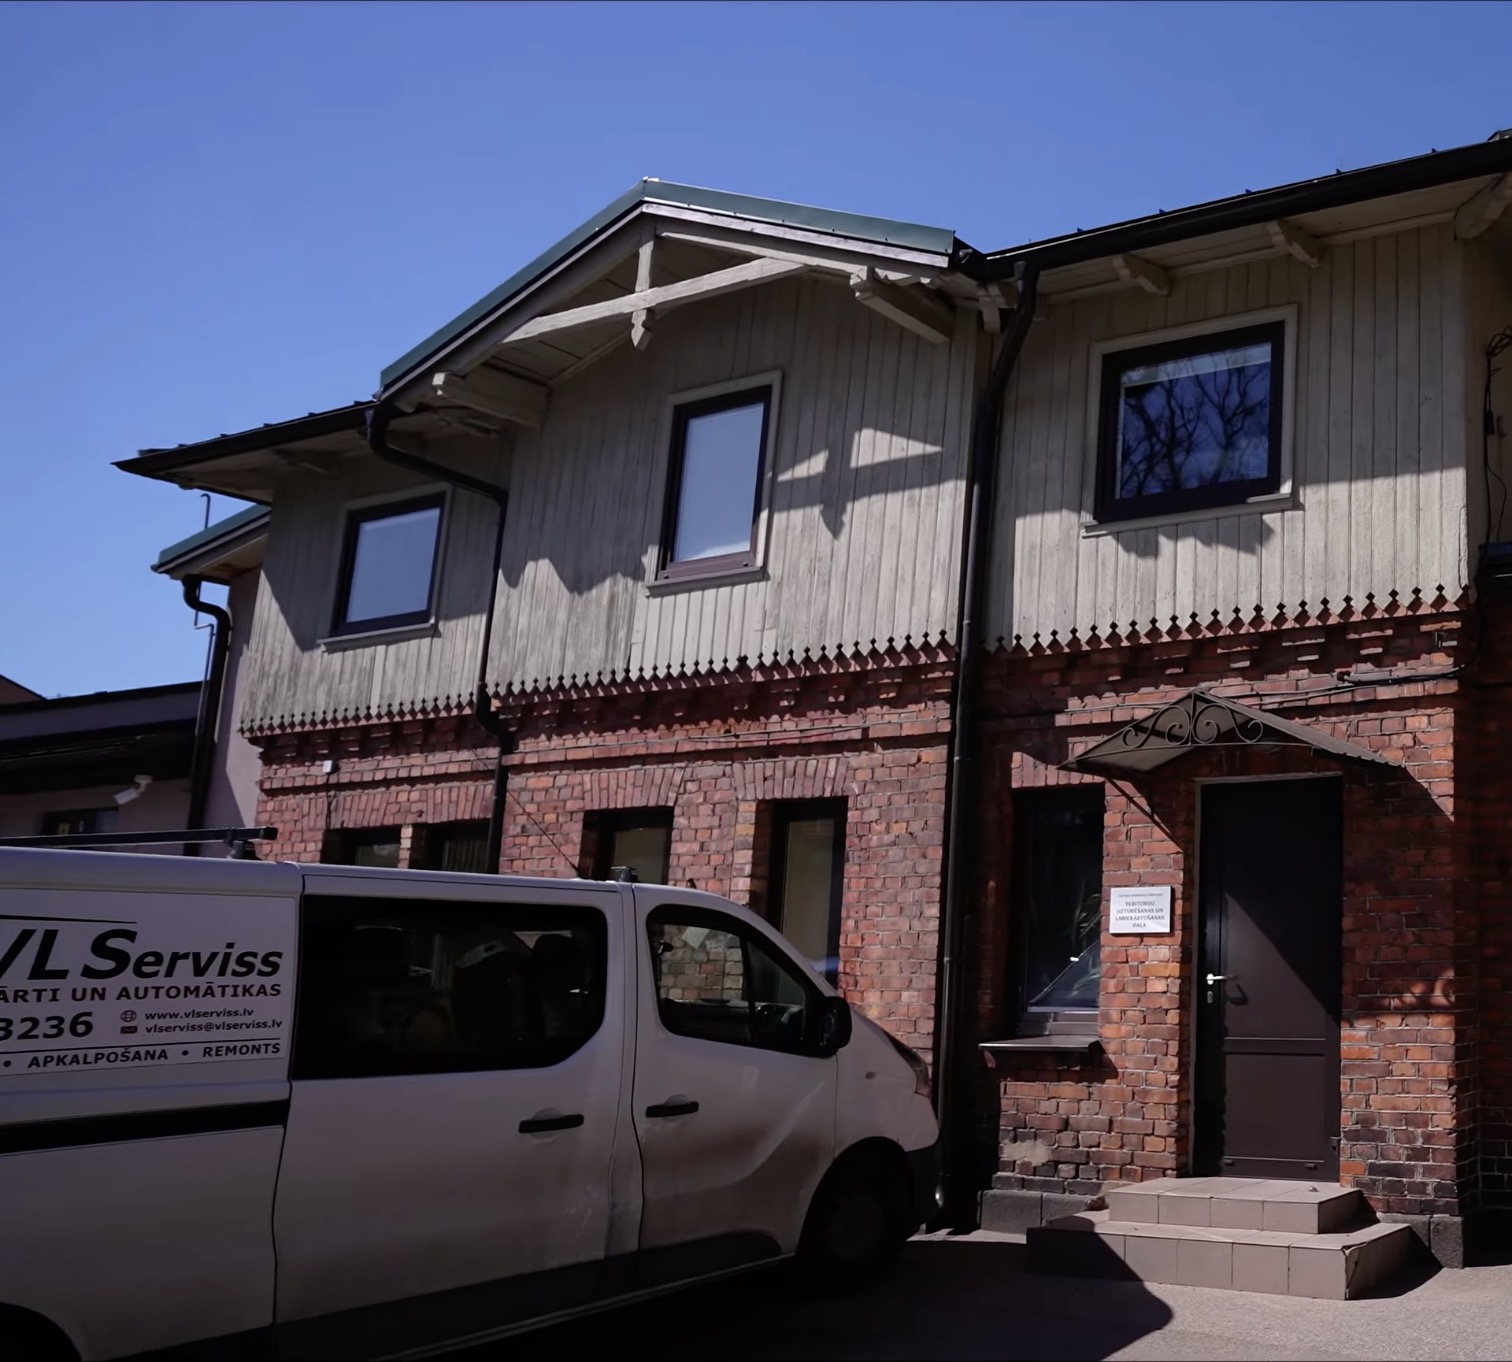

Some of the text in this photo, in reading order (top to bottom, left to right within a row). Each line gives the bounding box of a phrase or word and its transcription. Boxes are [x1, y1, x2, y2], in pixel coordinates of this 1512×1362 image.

[80, 928, 283, 981] Serviss
[71, 987, 107, 1001] UN
[116, 981, 282, 1001] AUTOMĀTIKAS
[144, 1008, 255, 1020] www.vlserviss.lv
[145, 1019, 283, 1034] vlserviss@vlserviss.lv
[27, 1042, 281, 1069] APKALPOŠANA REMONTS
